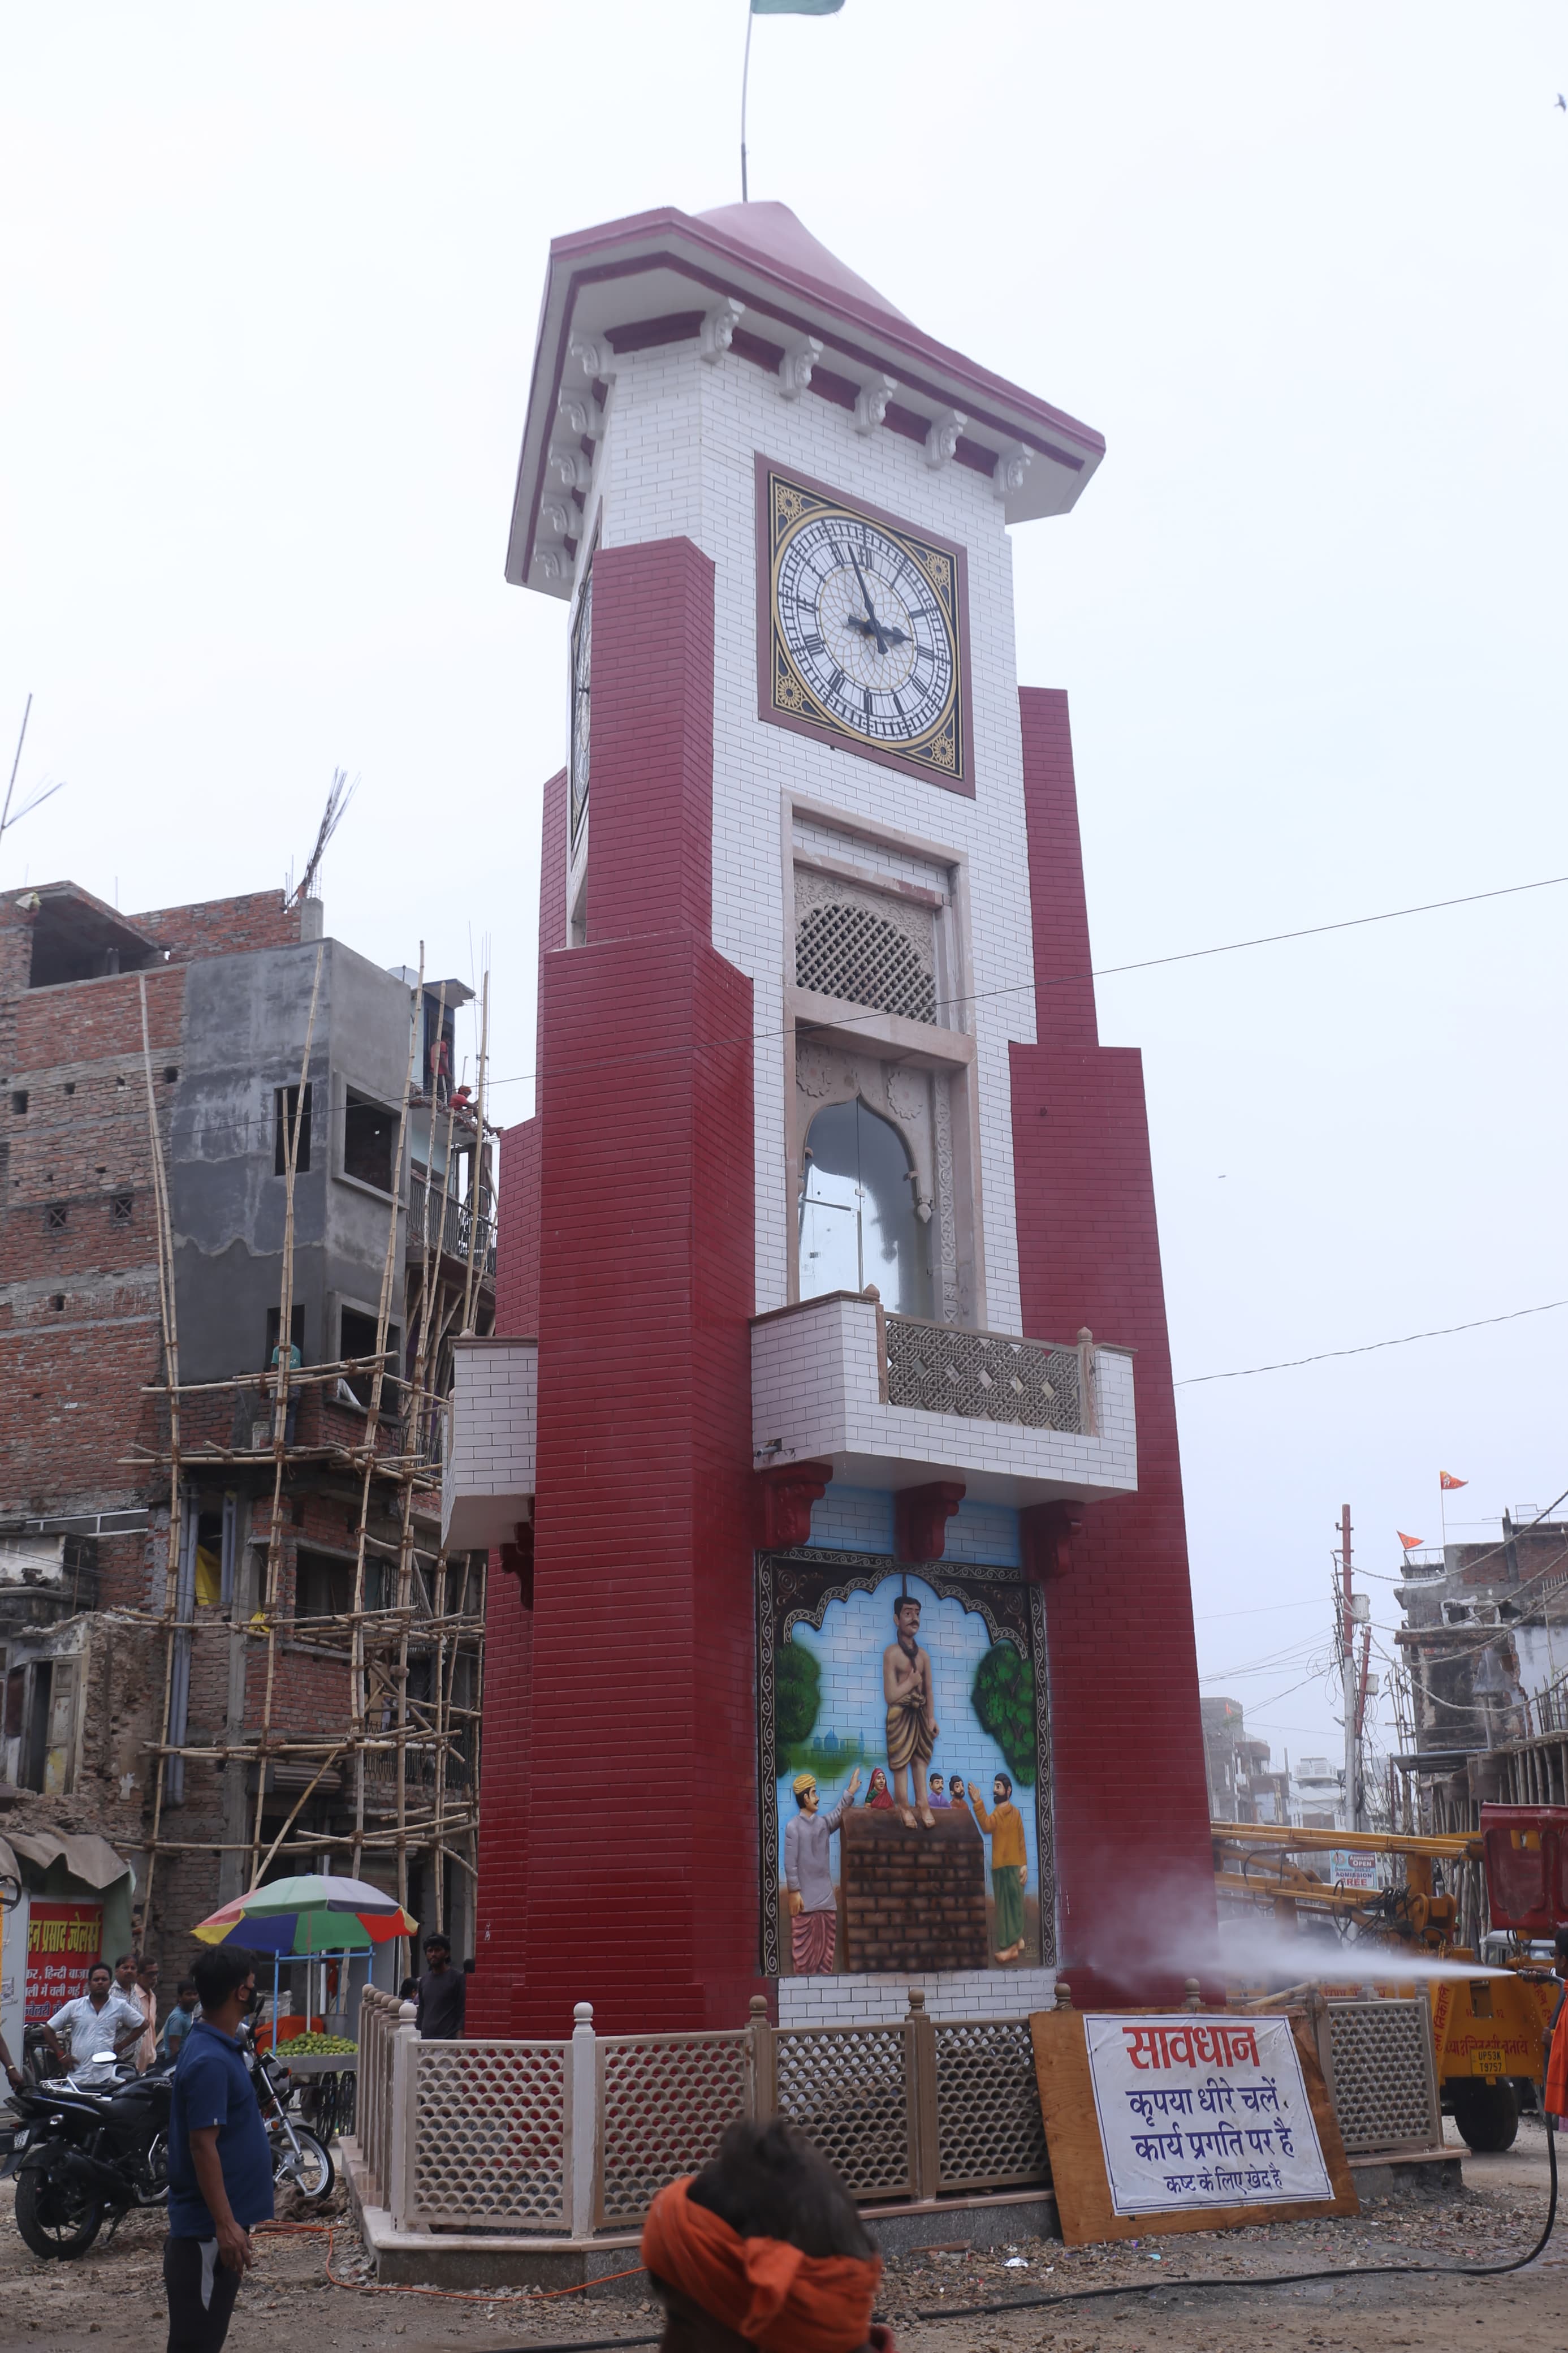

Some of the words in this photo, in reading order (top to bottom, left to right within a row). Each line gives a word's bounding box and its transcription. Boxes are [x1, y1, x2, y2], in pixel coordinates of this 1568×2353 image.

[42, 1920, 68, 1953] प्रसाद
[45, 1966, 67, 1979] हिन्दी
[25, 1983, 38, 1997] ली
[50, 1983, 65, 1996] चली
[1122, 2026, 1260, 2069] सावधान
[1480, 2062, 1502, 2072] T9757
[1126, 2089, 1193, 2126] कृपया
[1198, 2076, 1236, 2114] धीरे
[1237, 2076, 1280, 2112] चलें
[1131, 2122, 1182, 2162] कार्य
[1186, 2121, 1244, 2160] प्रगति
[1245, 2129, 1275, 2156] पर
[1275, 2117, 1294, 2157] है
[1164, 2174, 1196, 2194] कष्ट
[1198, 2166, 1213, 2192] के
[1215, 2166, 1246, 2195] लिए
[1248, 2165, 1270, 2191] खेद
[1271, 2162, 1282, 2190] है
